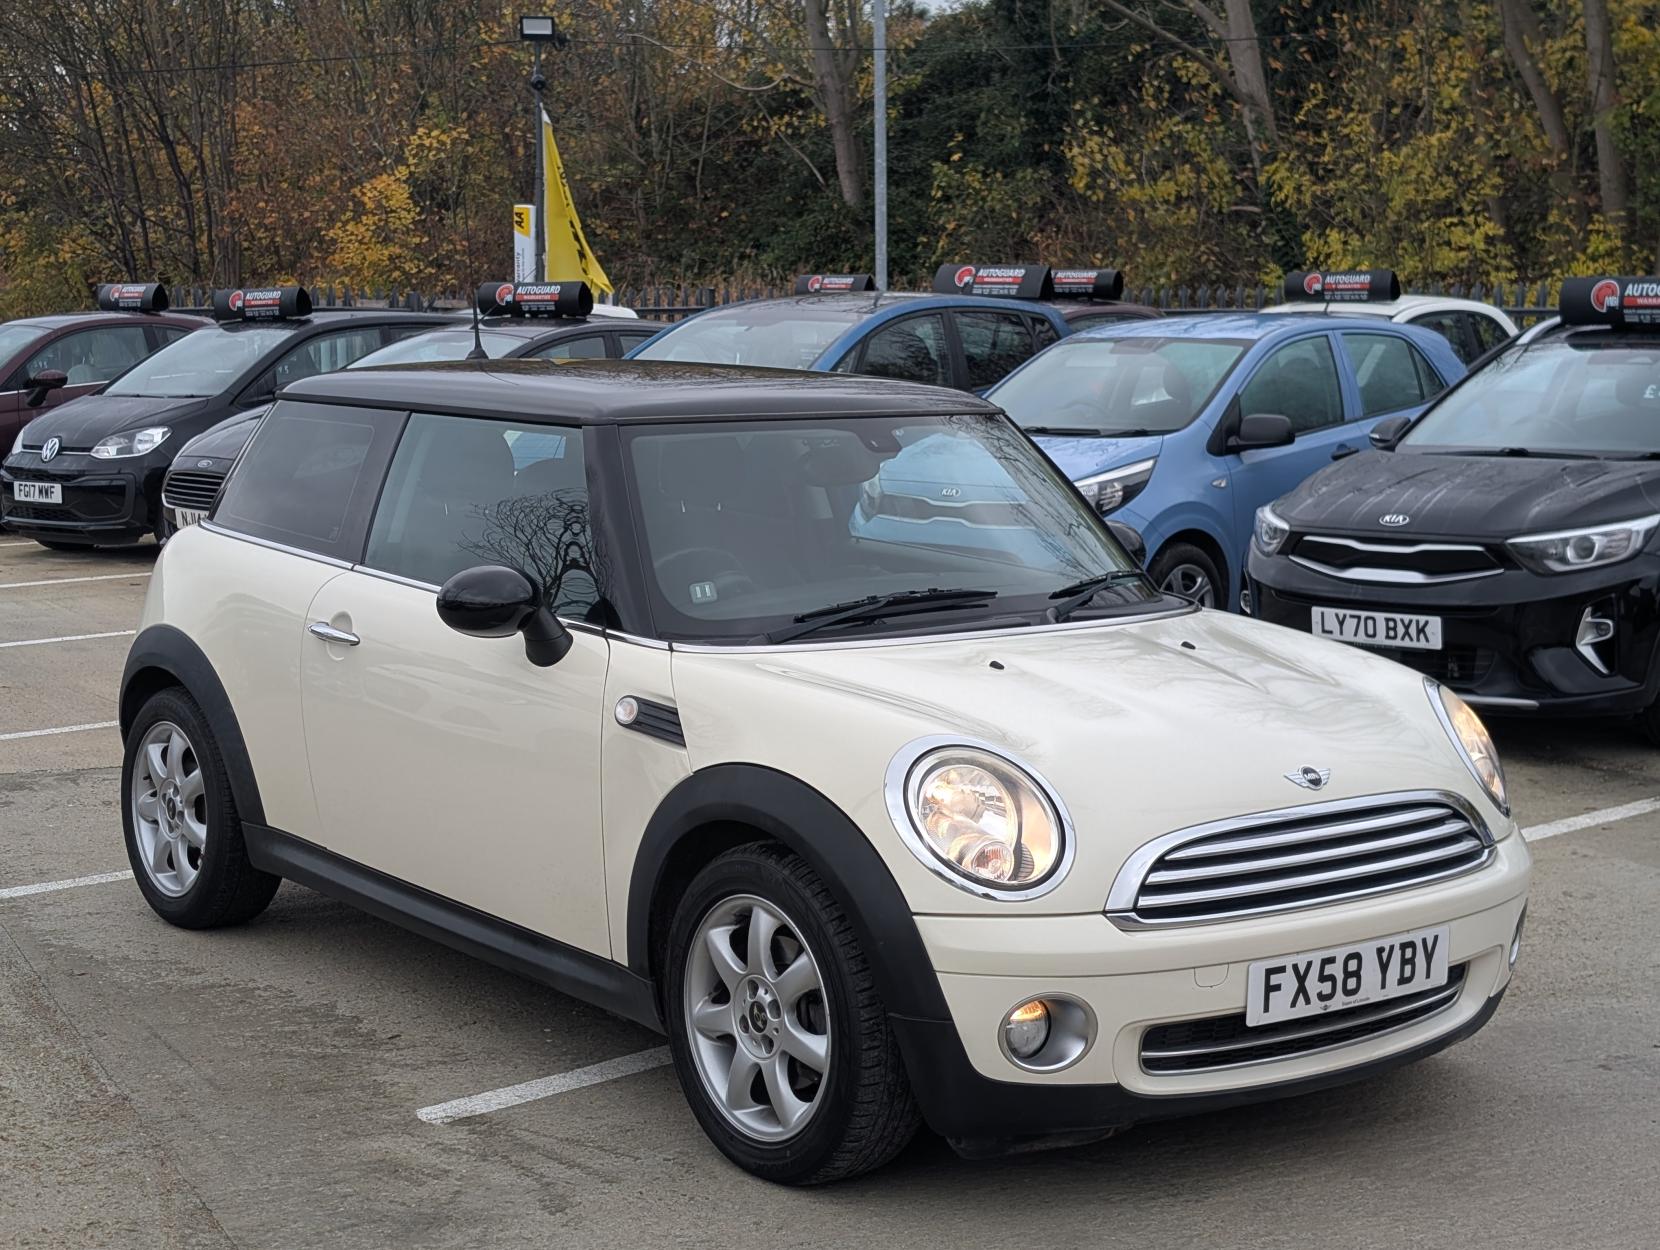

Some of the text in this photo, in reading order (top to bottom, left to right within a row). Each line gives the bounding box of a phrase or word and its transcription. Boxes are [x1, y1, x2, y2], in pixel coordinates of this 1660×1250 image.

[514, 211, 525, 229] AA
[976, 268, 1026, 277] AUTOGUARD
[1324, 274, 1371, 284] AUTOGUARD
[245, 290, 282, 300] AUTOGUARD
[516, 285, 561, 295] AUTOGUARD
[18, 483, 56, 499] FG17 MWF
[940, 488, 959, 497] KIA
[1382, 514, 1404, 524] KIA
[1320, 611, 1430, 644] LY70 BXK
[1263, 934, 1439, 1014] FX58 YBY
